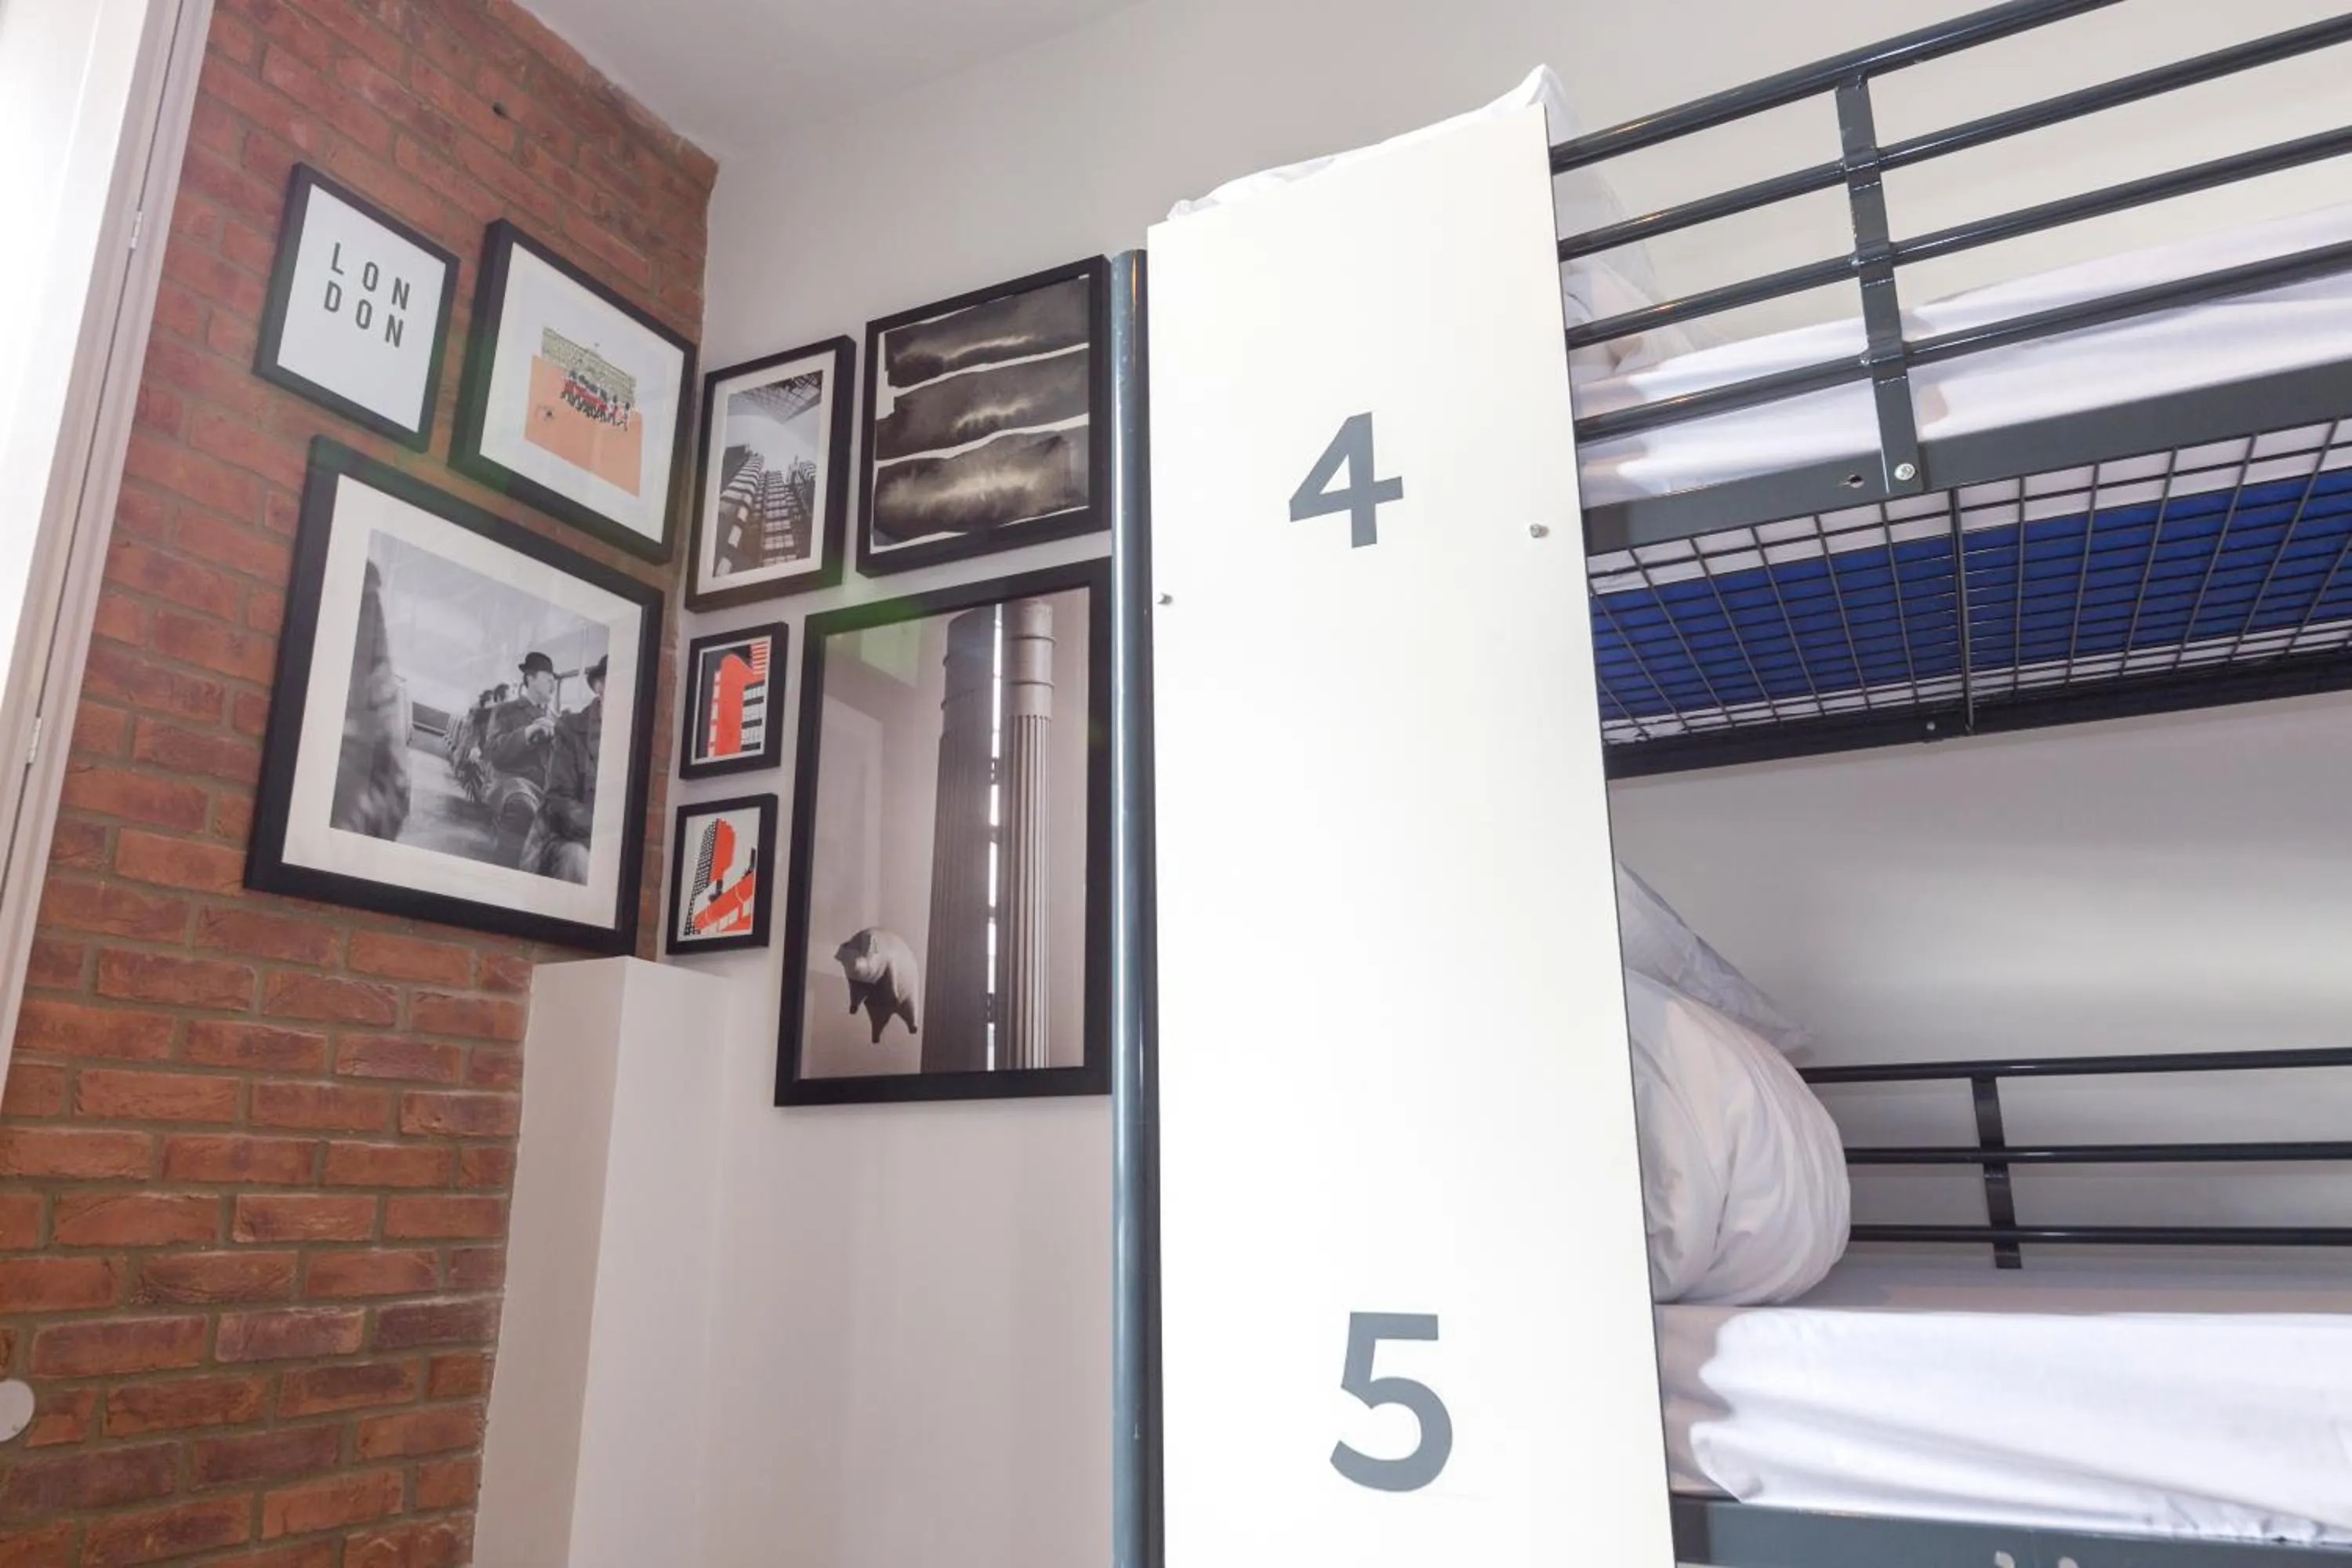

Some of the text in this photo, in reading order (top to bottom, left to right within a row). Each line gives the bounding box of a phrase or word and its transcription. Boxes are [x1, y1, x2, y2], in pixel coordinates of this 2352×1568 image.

[324, 280, 404, 348] DON
[331, 242, 410, 310] LON
[1289, 412, 1404, 549] 4
[1330, 1312, 1453, 1492] 5
